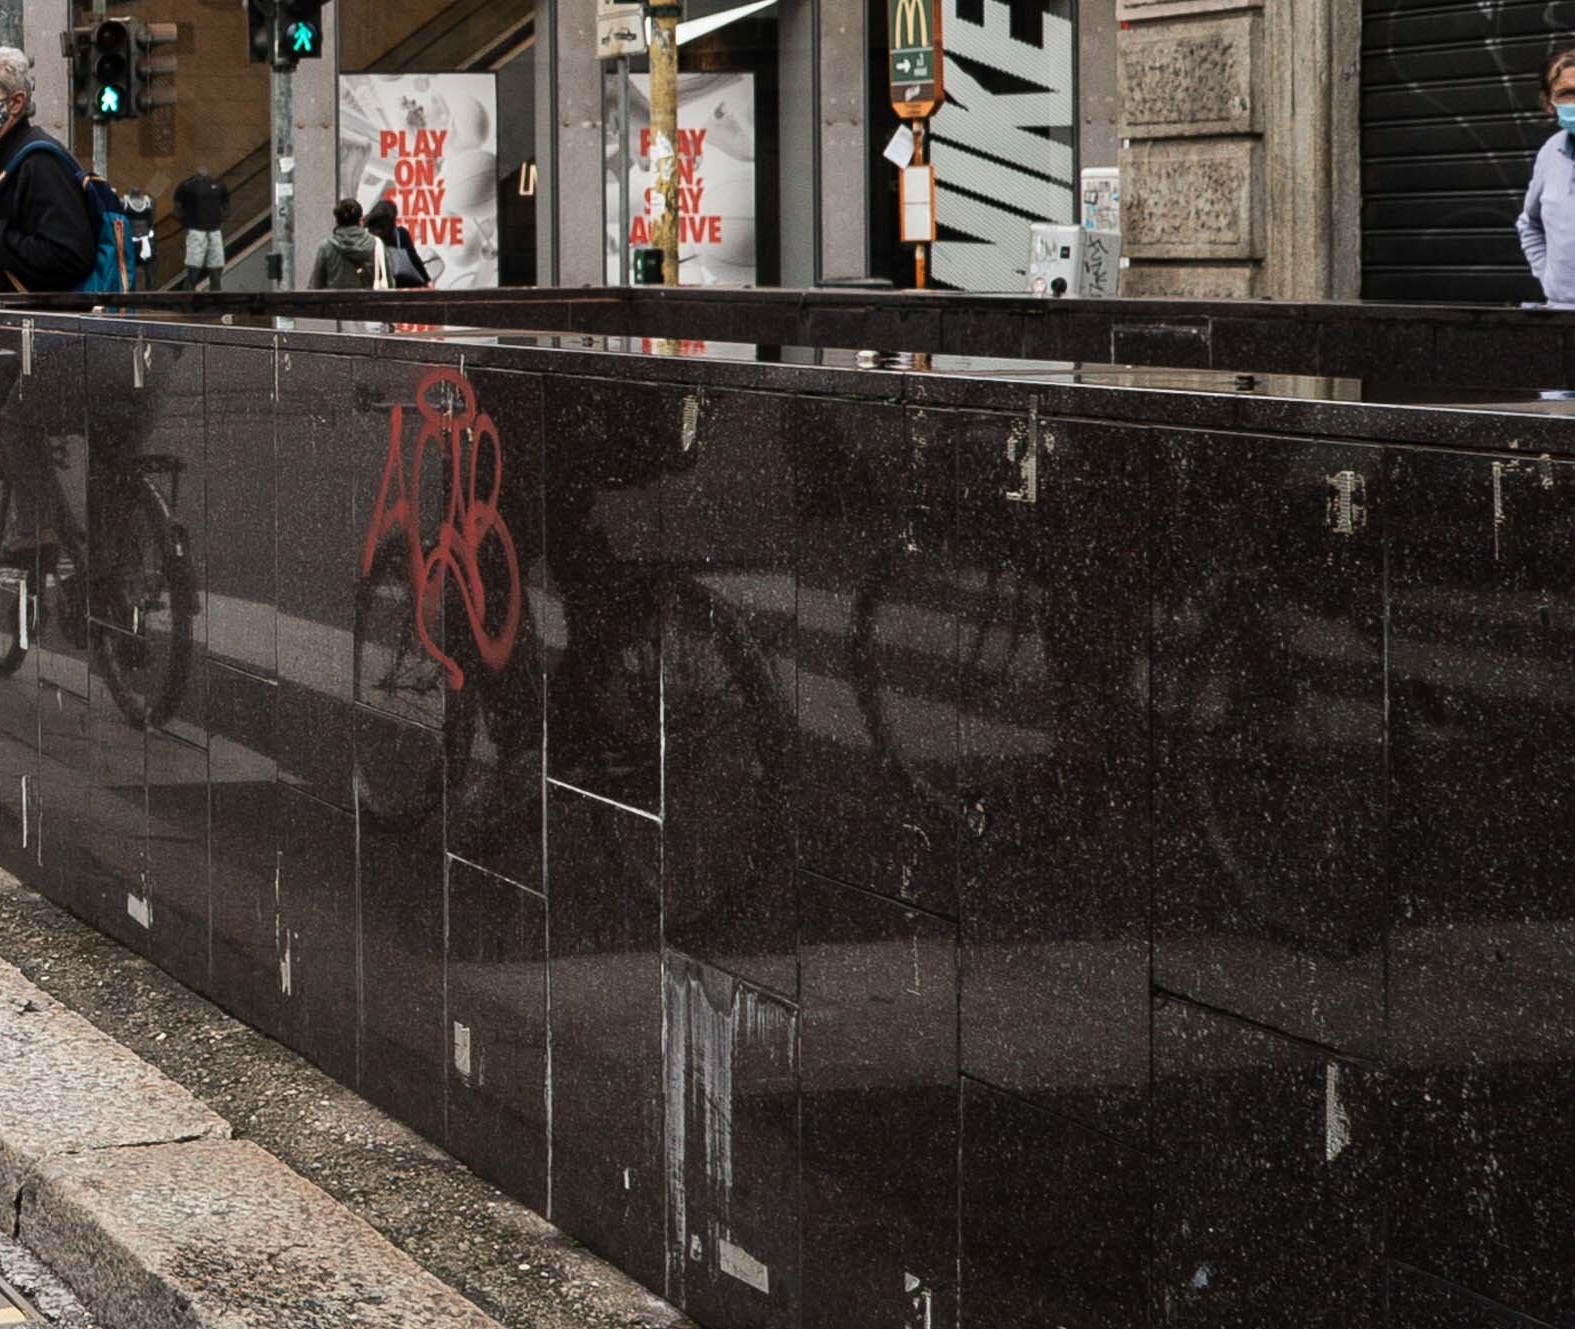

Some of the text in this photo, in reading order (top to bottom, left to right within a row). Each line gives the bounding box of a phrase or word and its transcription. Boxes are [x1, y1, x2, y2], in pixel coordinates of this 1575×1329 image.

[380, 129, 448, 159] PLAY
[640, 128, 707, 157] PAY
[394, 160, 444, 189] ON,
[644, 187, 704, 215] SAY
[629, 216, 722, 245] AIVE
